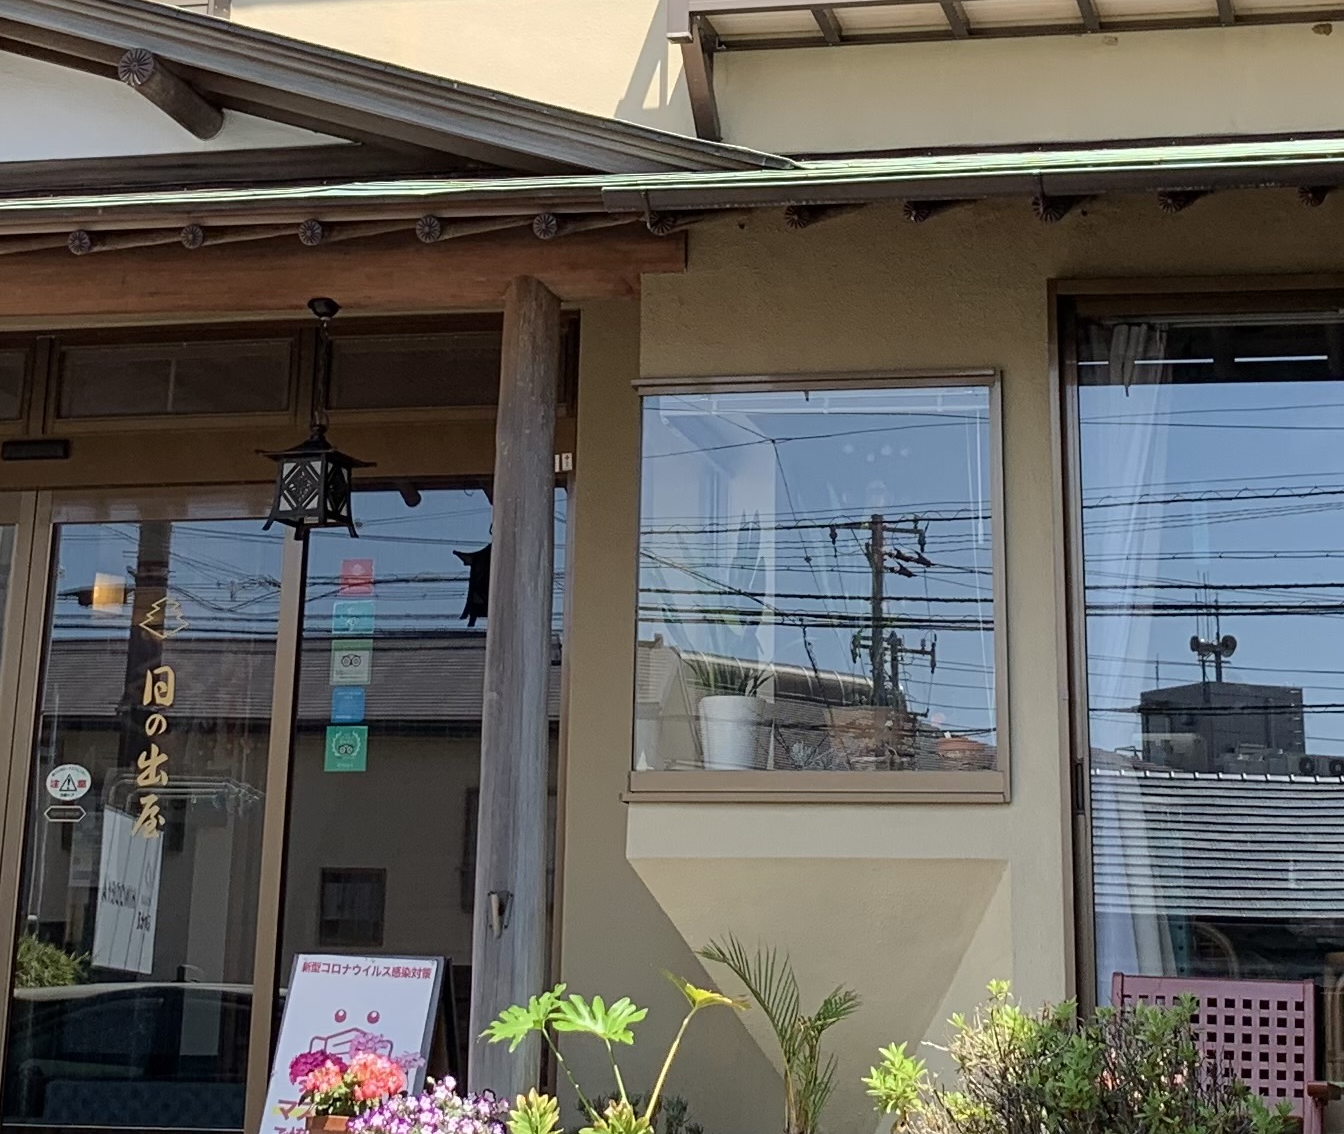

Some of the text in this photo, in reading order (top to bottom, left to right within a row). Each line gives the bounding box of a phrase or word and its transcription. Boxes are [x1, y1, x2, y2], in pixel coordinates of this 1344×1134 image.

[131, 665, 176, 838] 日の出屋
[301, 961, 433, 980] 新型コロナウイルス感染対策
